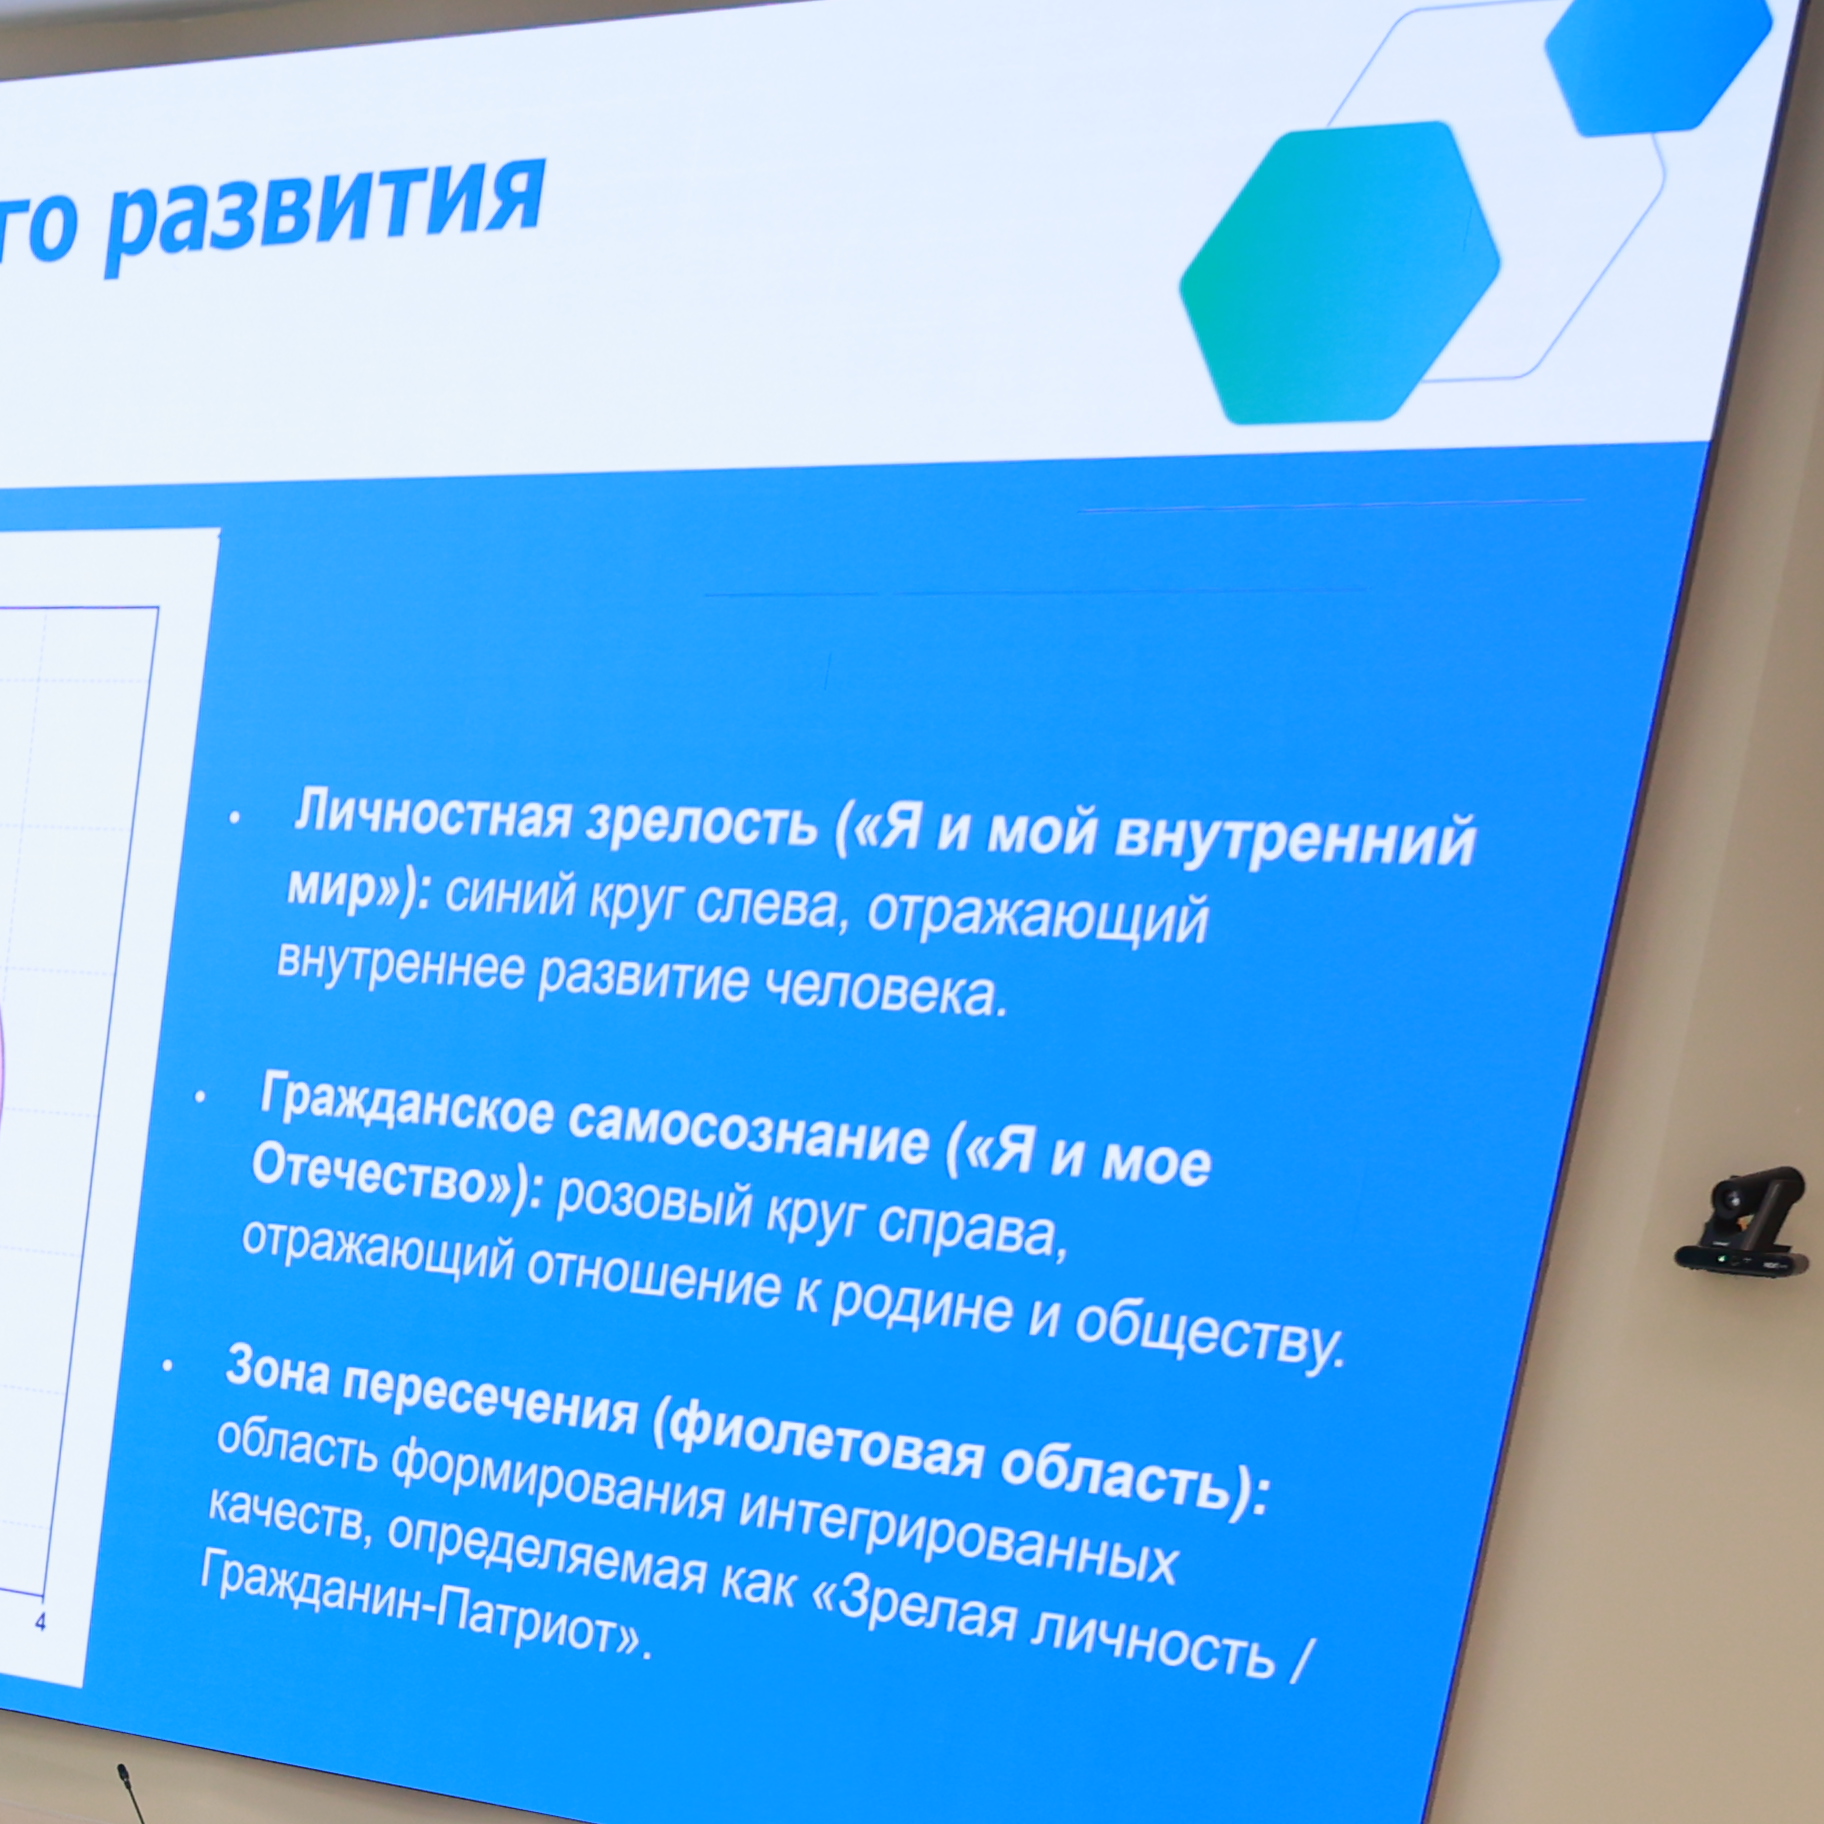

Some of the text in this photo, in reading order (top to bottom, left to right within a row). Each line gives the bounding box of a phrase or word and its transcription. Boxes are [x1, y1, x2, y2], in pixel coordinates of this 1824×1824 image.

[104, 158, 546, 279] развития
[295, 786, 1477, 872] Личностная зрелость («Я и мой внутренний
[288, 864, 1210, 950] мир»): синий круг слева, отражающий
[277, 942, 1007, 1017] внутреннее развитие человека.
[262, 1069, 1213, 1188] Гражданское самосознание («Я и мое
[253, 1140, 1066, 1264] Отечество»): розовый круг справа,
[243, 1221, 1343, 1378] отражающий отношение к родине и обществу.
[226, 1342, 1270, 1523] Зона пересечения (фиолетовая область):
[218, 1416, 1180, 1585] область формирования интегрированных
[35, 1612, 46, 1631] 4
[202, 1543, 653, 1659] Гражданин-Патриот».
[210, 1489, 1318, 1685] качеств, определяемая как «Зрелая личность /
